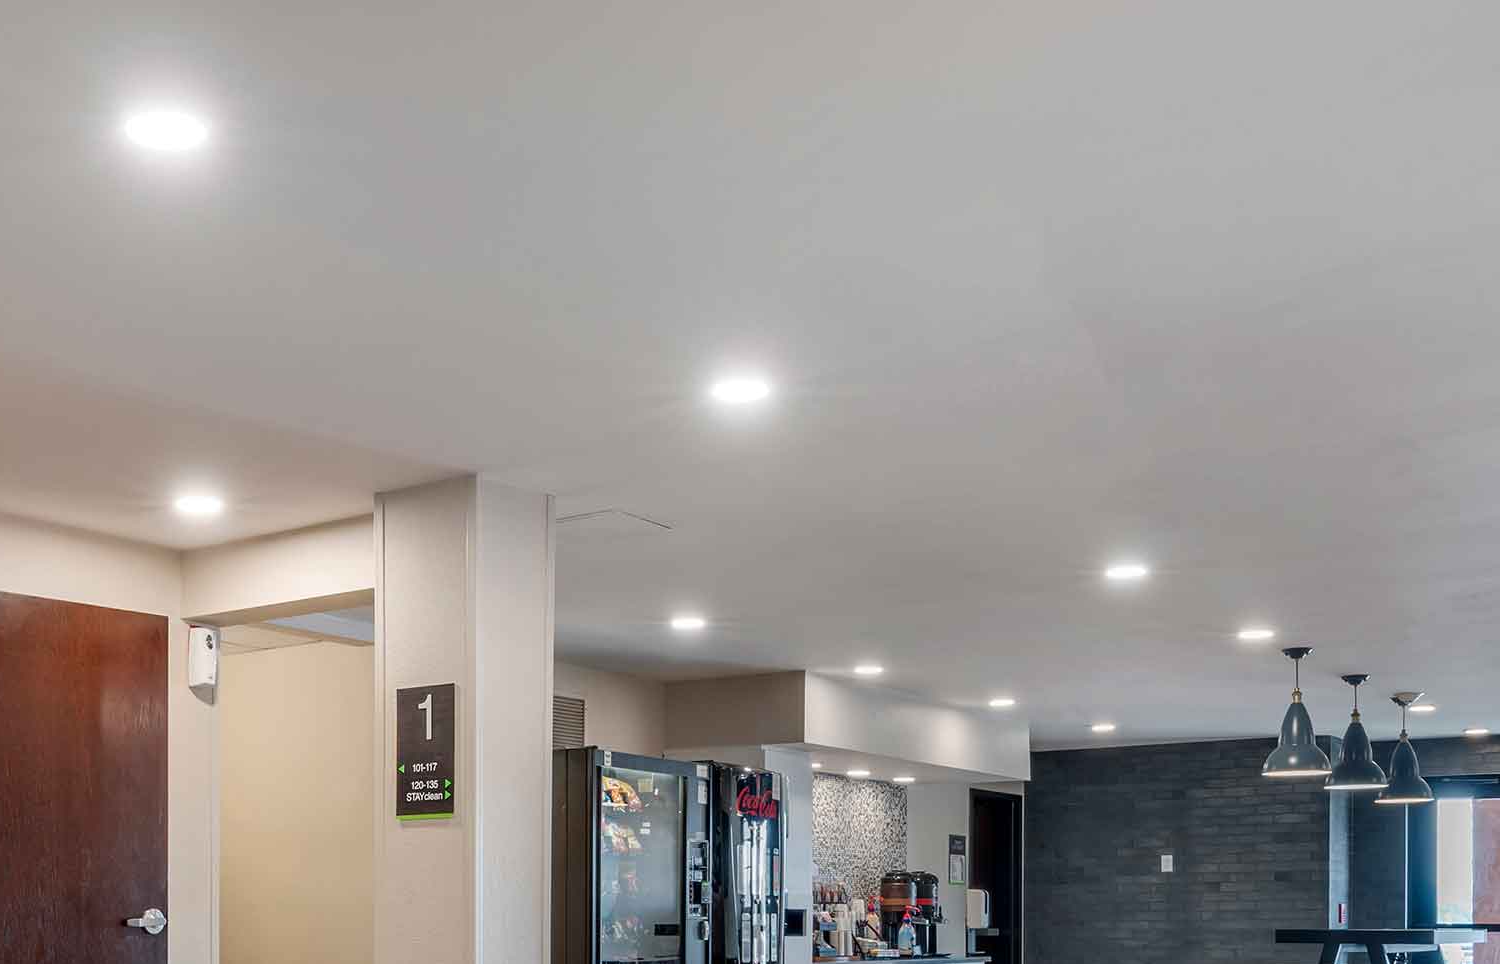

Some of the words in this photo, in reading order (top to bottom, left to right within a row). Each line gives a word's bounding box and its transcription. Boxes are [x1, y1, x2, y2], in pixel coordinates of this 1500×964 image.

[418, 693, 432, 741] 1
[412, 762, 438, 773] 101-117
[411, 780, 439, 790] 120-135
[406, 792, 443, 802] STAYclean
